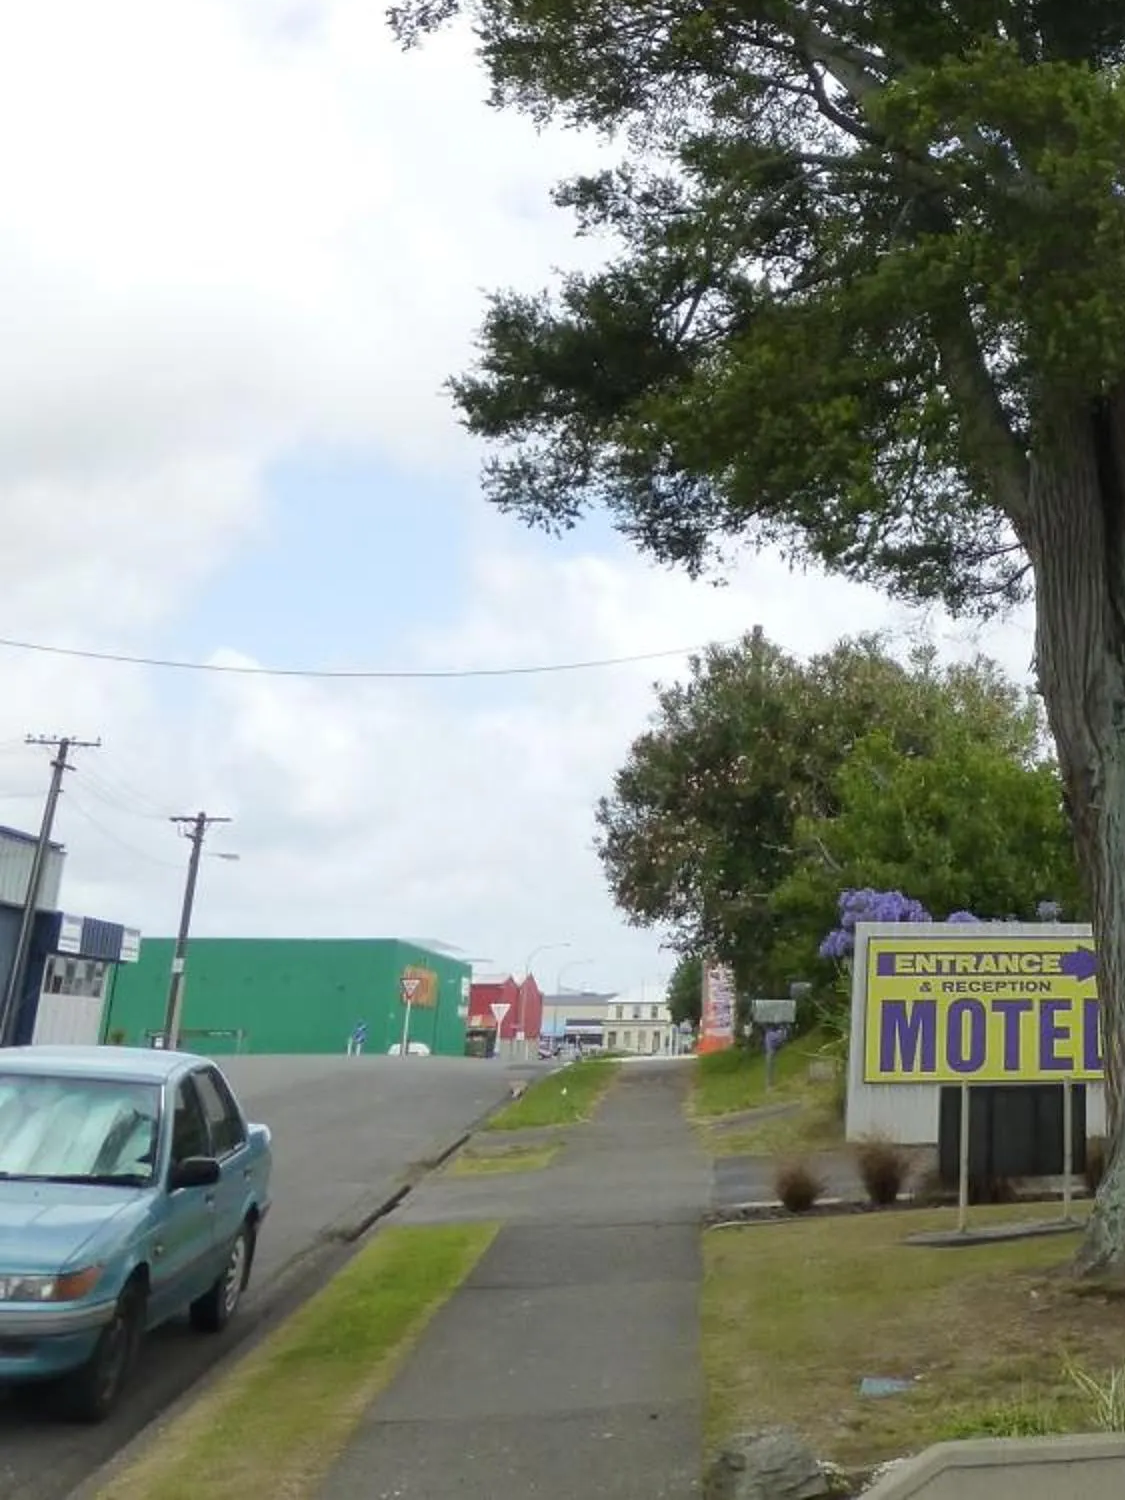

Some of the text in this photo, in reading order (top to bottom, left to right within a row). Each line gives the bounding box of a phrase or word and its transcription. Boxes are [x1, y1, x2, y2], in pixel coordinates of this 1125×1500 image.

[894, 953, 1062, 974] ENTRANCE
[919, 980, 1052, 993] & RECEPTION
